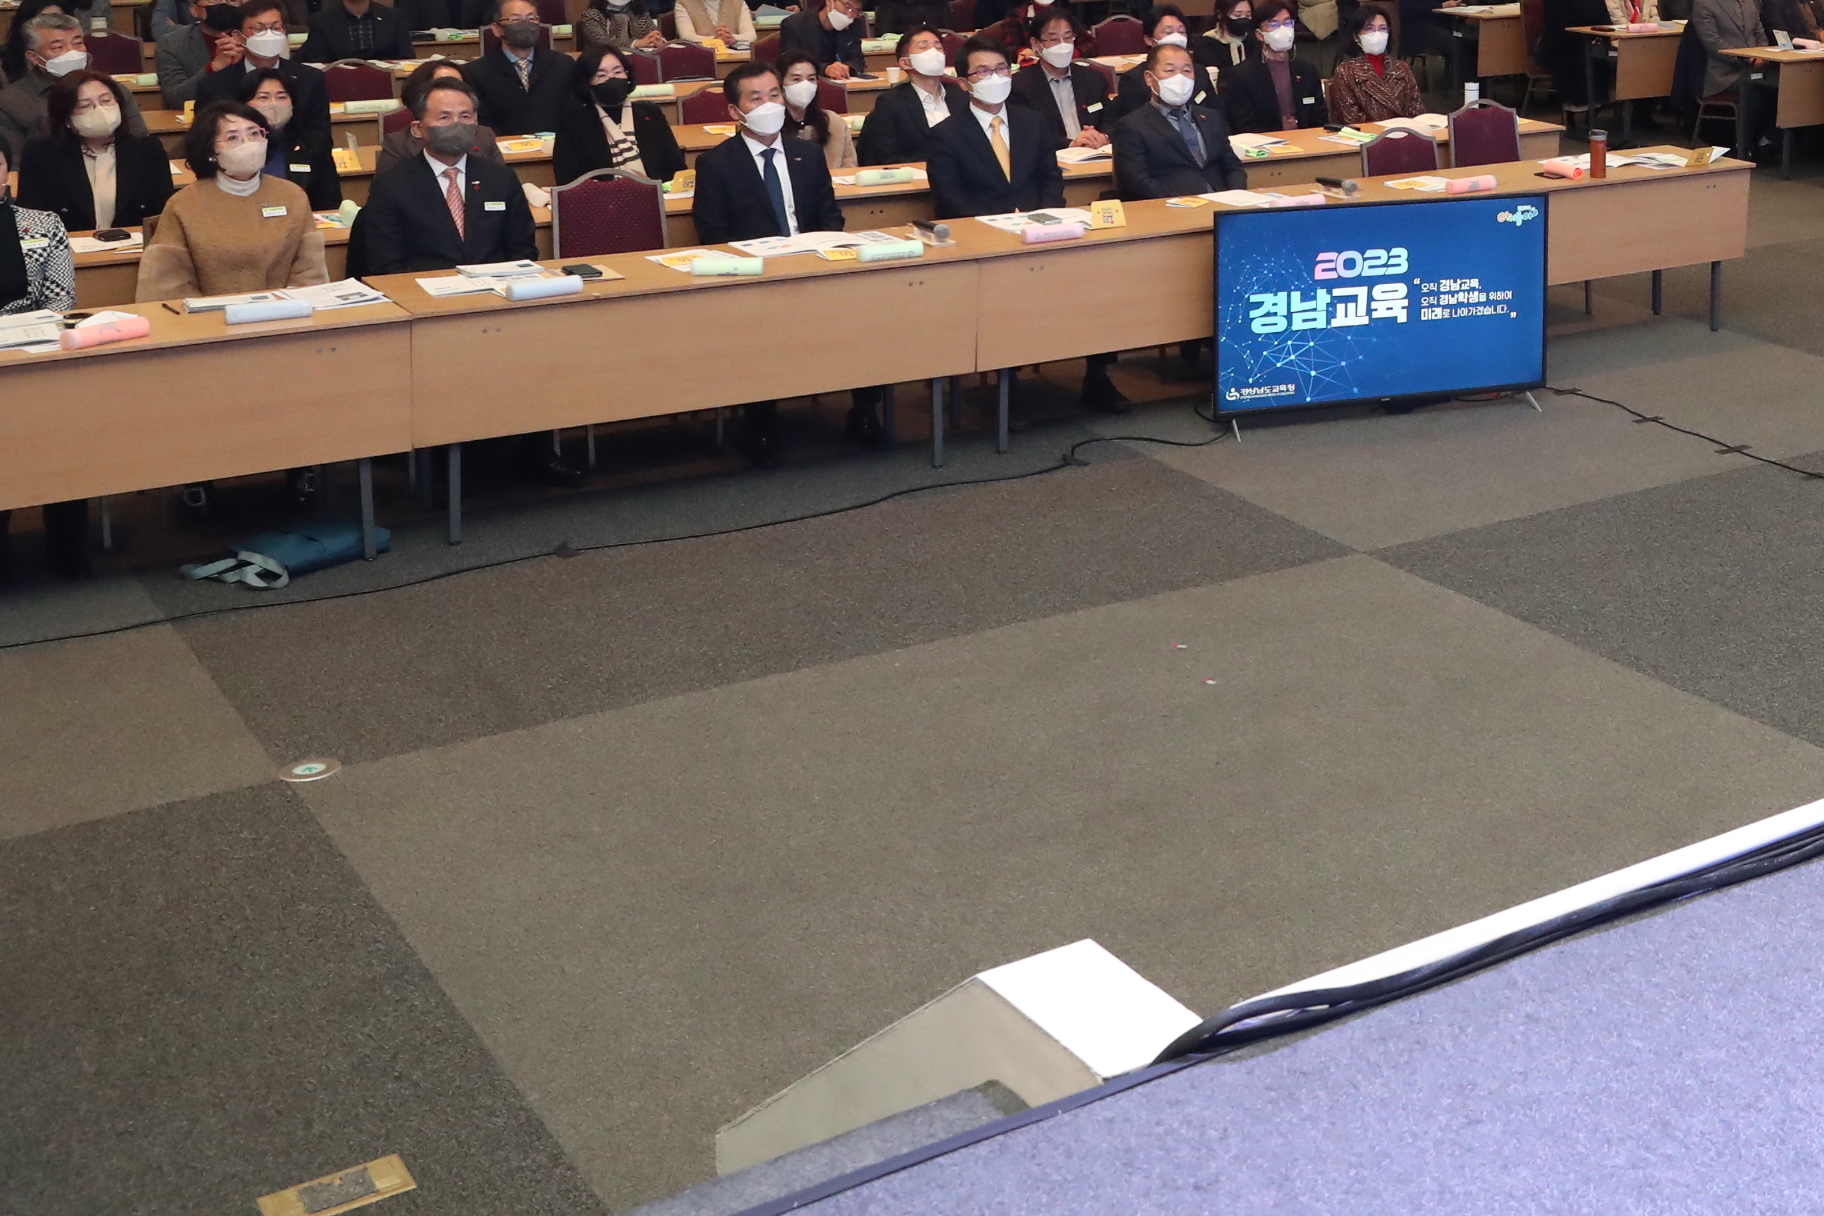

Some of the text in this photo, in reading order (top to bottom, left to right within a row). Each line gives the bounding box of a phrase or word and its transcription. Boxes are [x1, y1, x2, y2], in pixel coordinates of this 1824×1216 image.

[1314, 247, 1409, 280] 2023
[1440, 278, 1482, 292] 경남교육,
[1421, 290, 1513, 306] 오직 경남학생을 위하여
[1249, 282, 1409, 334] 경남교육
[1421, 307, 1451, 321] 미래로
